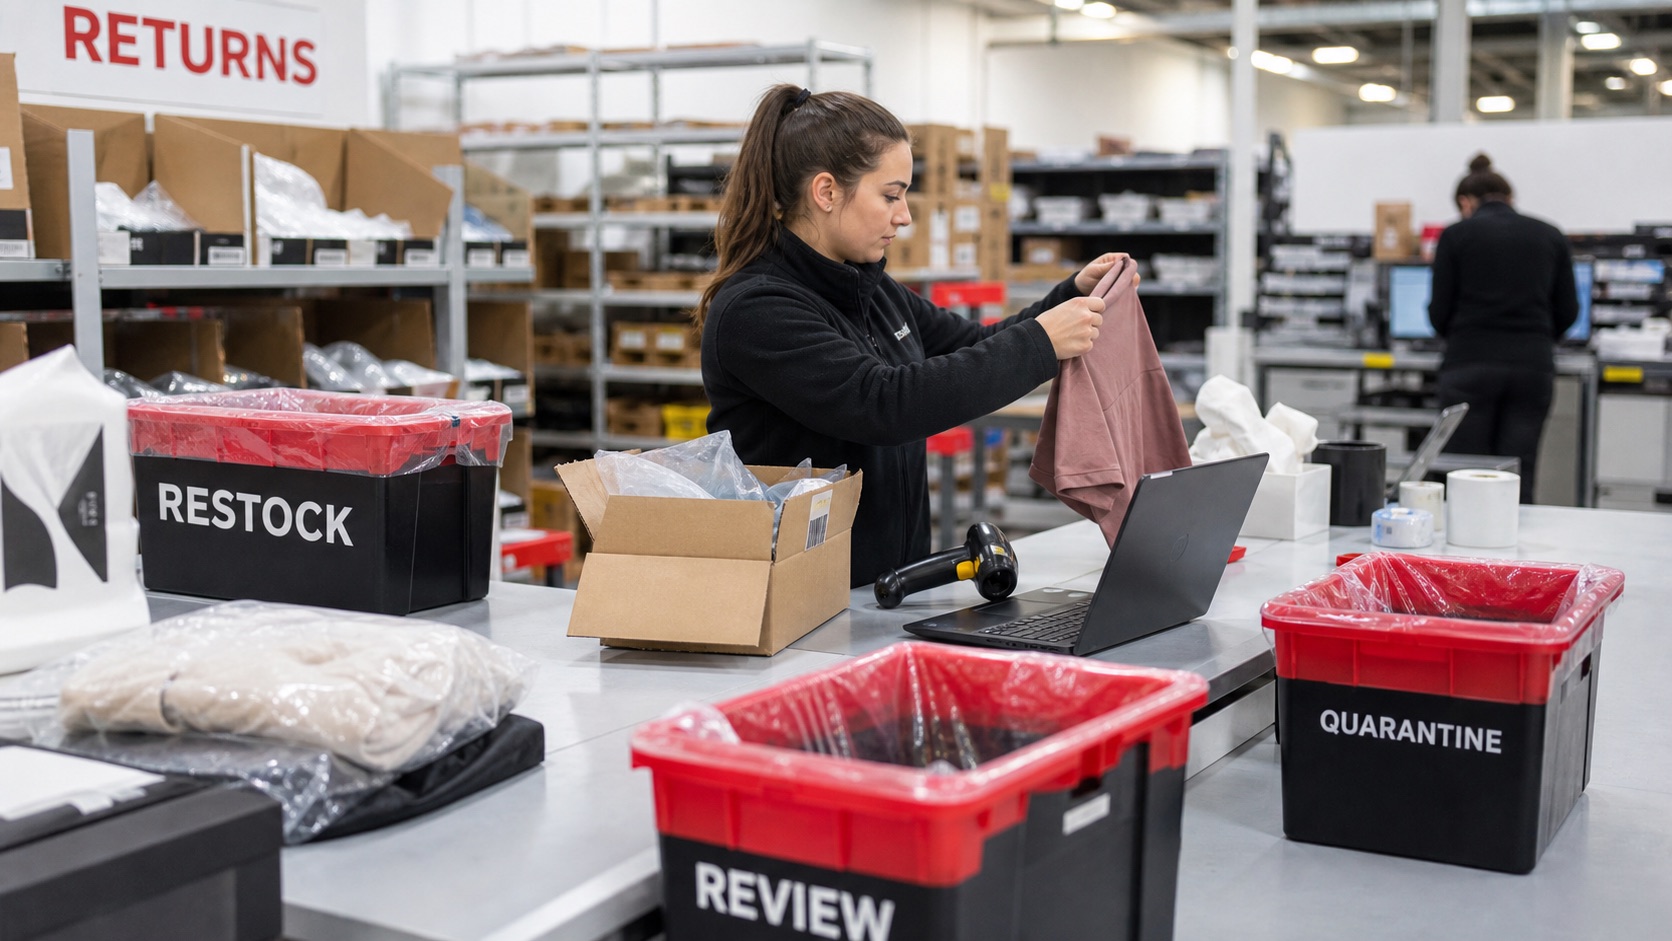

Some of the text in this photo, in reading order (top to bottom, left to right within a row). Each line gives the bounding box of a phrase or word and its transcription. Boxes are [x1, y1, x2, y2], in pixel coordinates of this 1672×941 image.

[63, 5, 318, 86] RETURNS
[157, 481, 354, 548] RESTOCK
[1319, 708, 1503, 755] QUARANTINE
[695, 861, 895, 941] REVIEW
